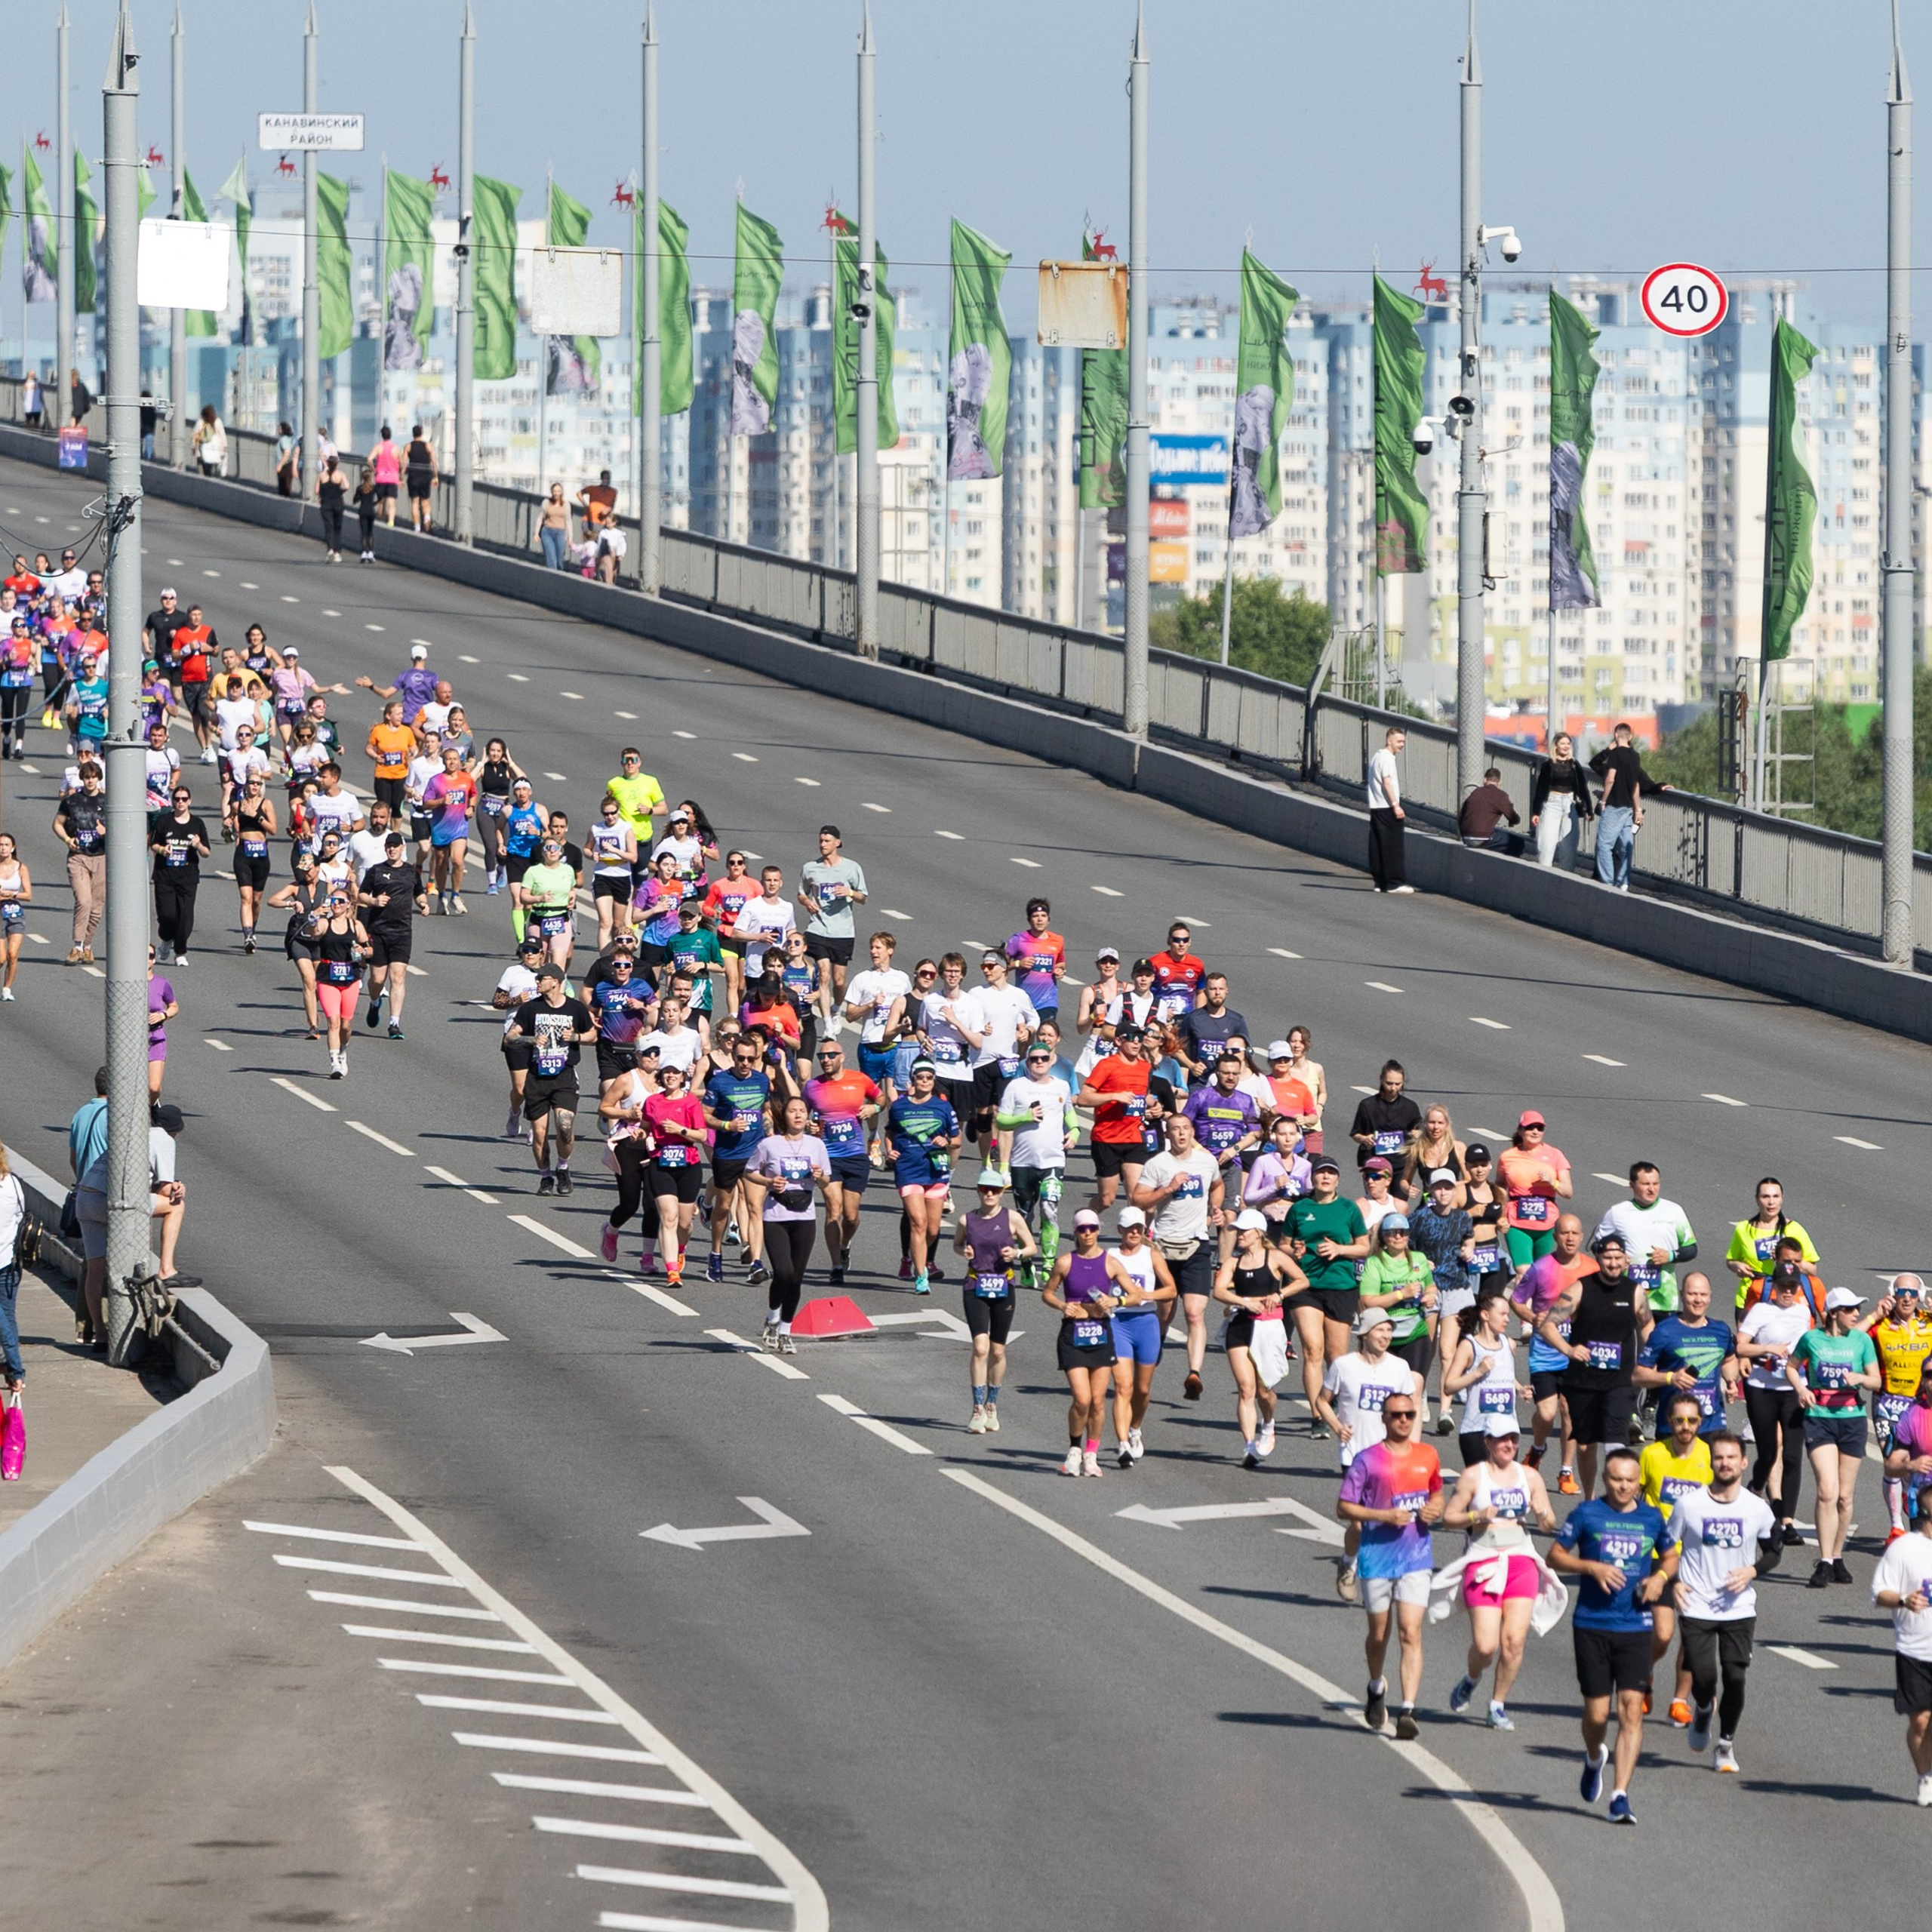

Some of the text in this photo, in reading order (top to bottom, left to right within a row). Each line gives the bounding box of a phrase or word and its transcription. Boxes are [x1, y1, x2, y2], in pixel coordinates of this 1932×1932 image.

[265, 117, 358, 128] КАНАВИНСКИЙ
[291, 132, 333, 144] РАЙОН
[1660, 285, 1708, 312] 40
[1035, 958, 1053, 966] 7321
[542, 1060, 561, 1068] 5313
[1130, 1099, 1144, 1108] 392
[831, 1122, 852, 1133] 7936
[1212, 1131, 1234, 1140] 5659
[1378, 1136, 1401, 1146] 4266
[663, 1149, 685, 1158] 3074
[1522, 1202, 1545, 1212] 3275
[1759, 1241, 1777, 1251] 475
[981, 1279, 1004, 1288] 3499
[1078, 1326, 1103, 1337] 5228
[1591, 1347, 1617, 1360] 4034
[1484, 1392, 1511, 1404] 5689
[1495, 1492, 1524, 1506] 4700
[1708, 1524, 1739, 1536] 4270
[1606, 1540, 1638, 1555] 4219
